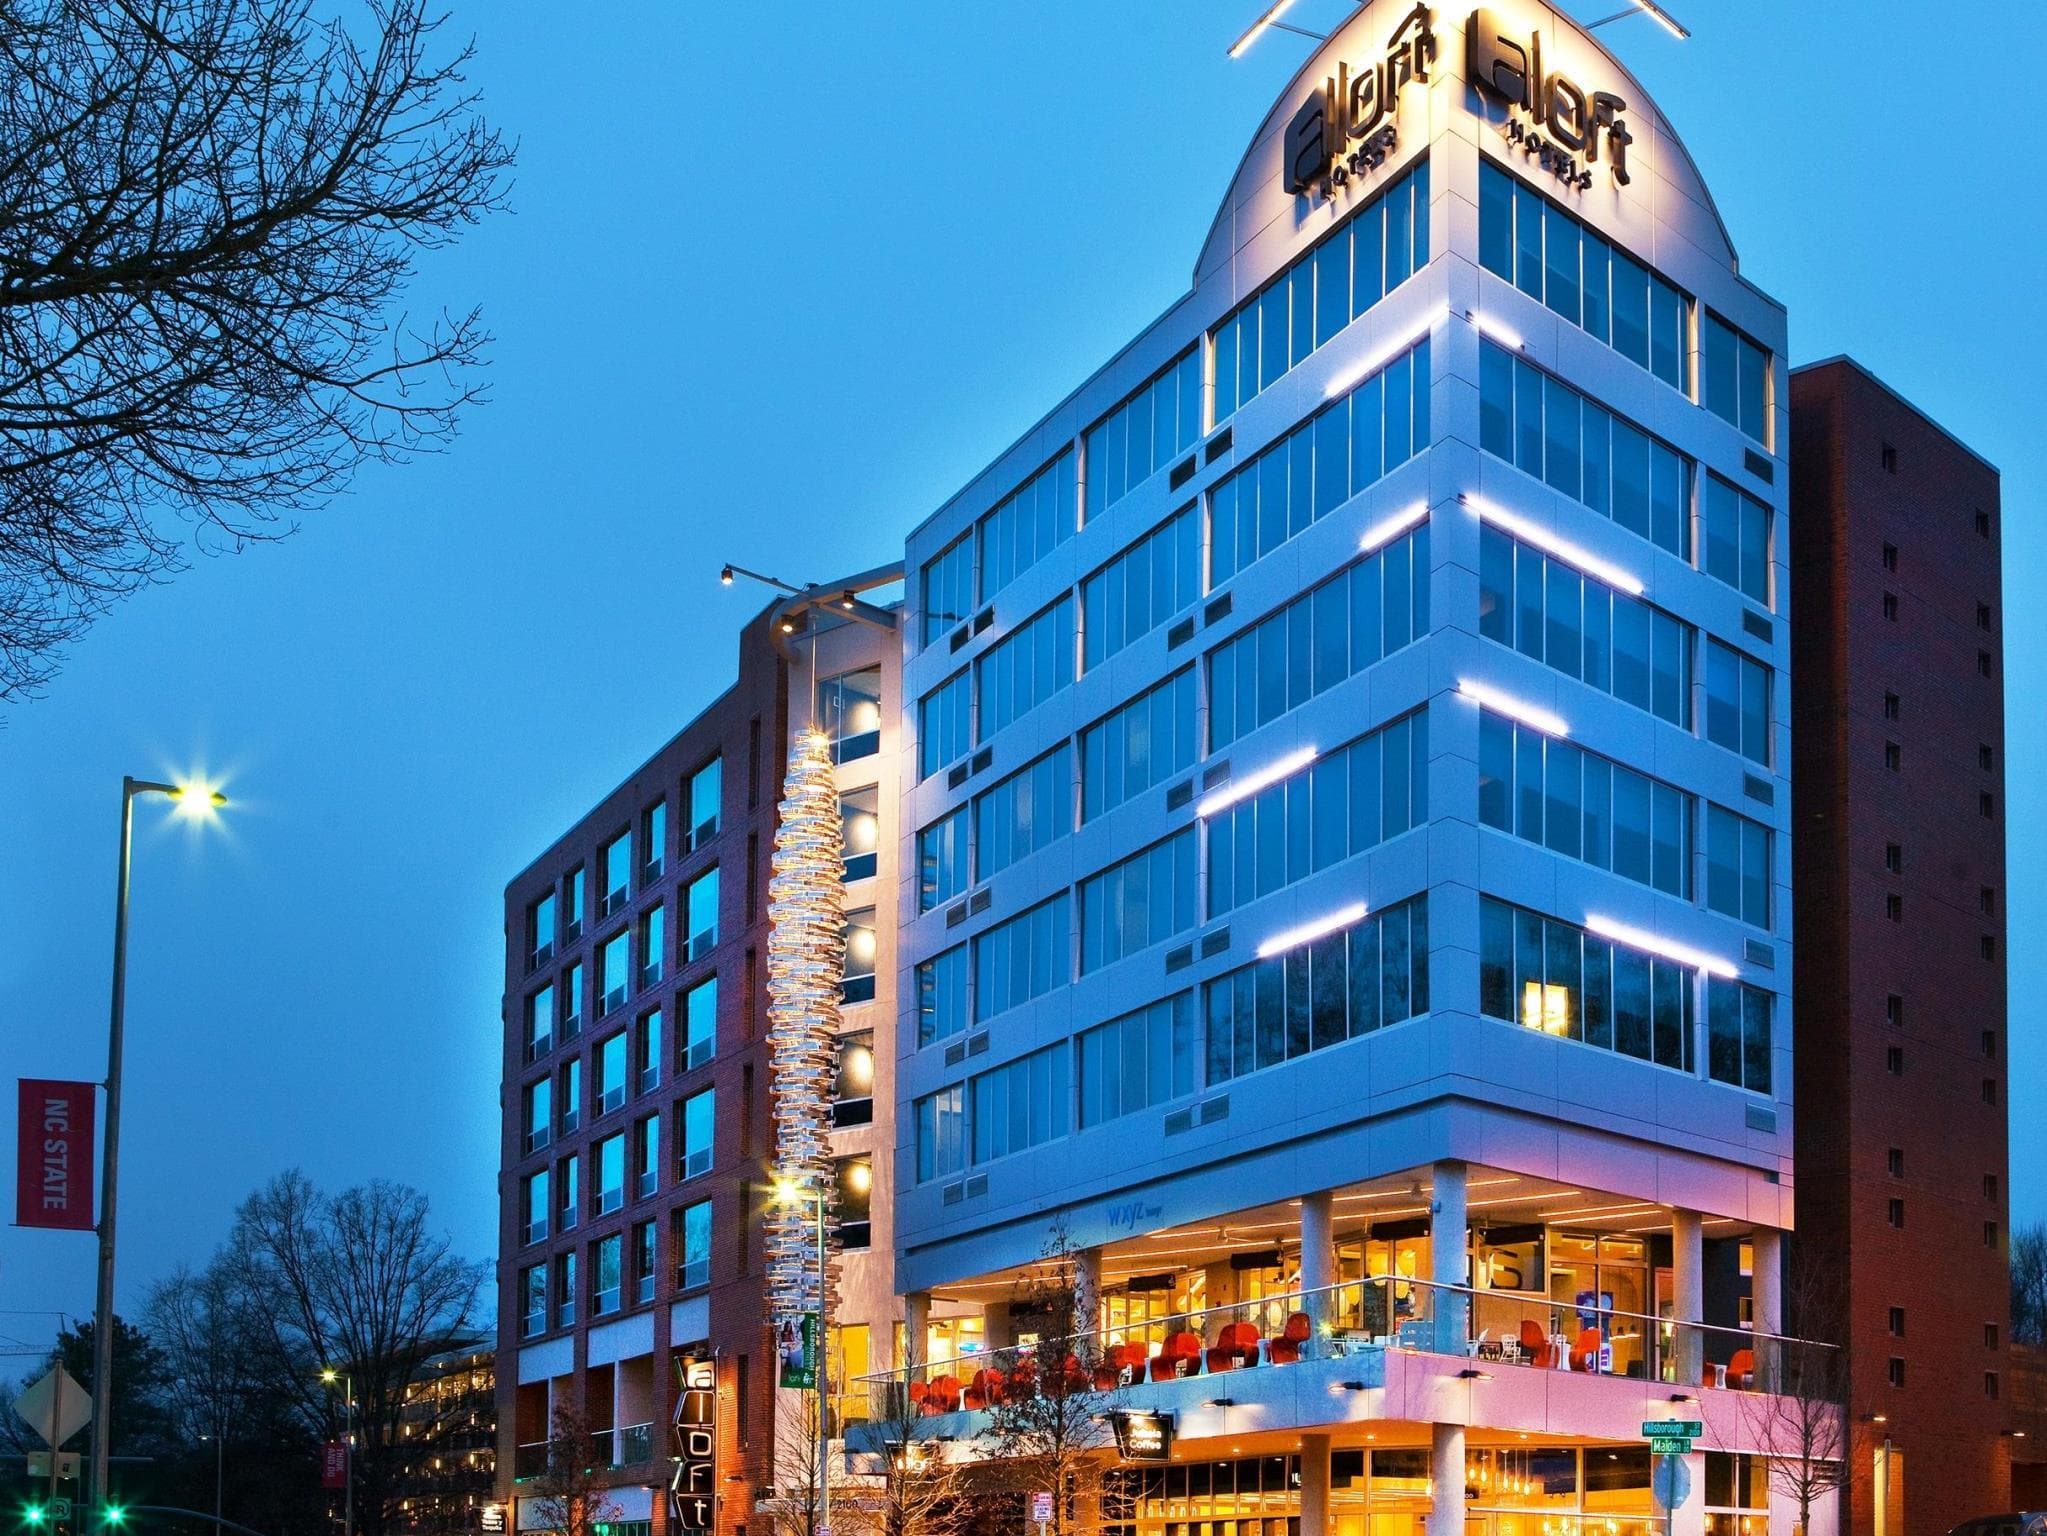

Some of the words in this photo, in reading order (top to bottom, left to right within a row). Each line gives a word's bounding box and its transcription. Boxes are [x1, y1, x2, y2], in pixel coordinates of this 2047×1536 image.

[1284, 1, 1436, 195] aloft
[1466, 9, 1633, 187] aloft
[43, 1098, 69, 1133] NC
[43, 1138, 68, 1210] STATE
[686, 1361, 715, 1526] aloft
[1129, 1439, 1162, 1450] Coffee
[1643, 1422, 1684, 1437] Hillsborough
[1653, 1439, 1681, 1452] Maiden
[336, 1448, 345, 1471] THINK
